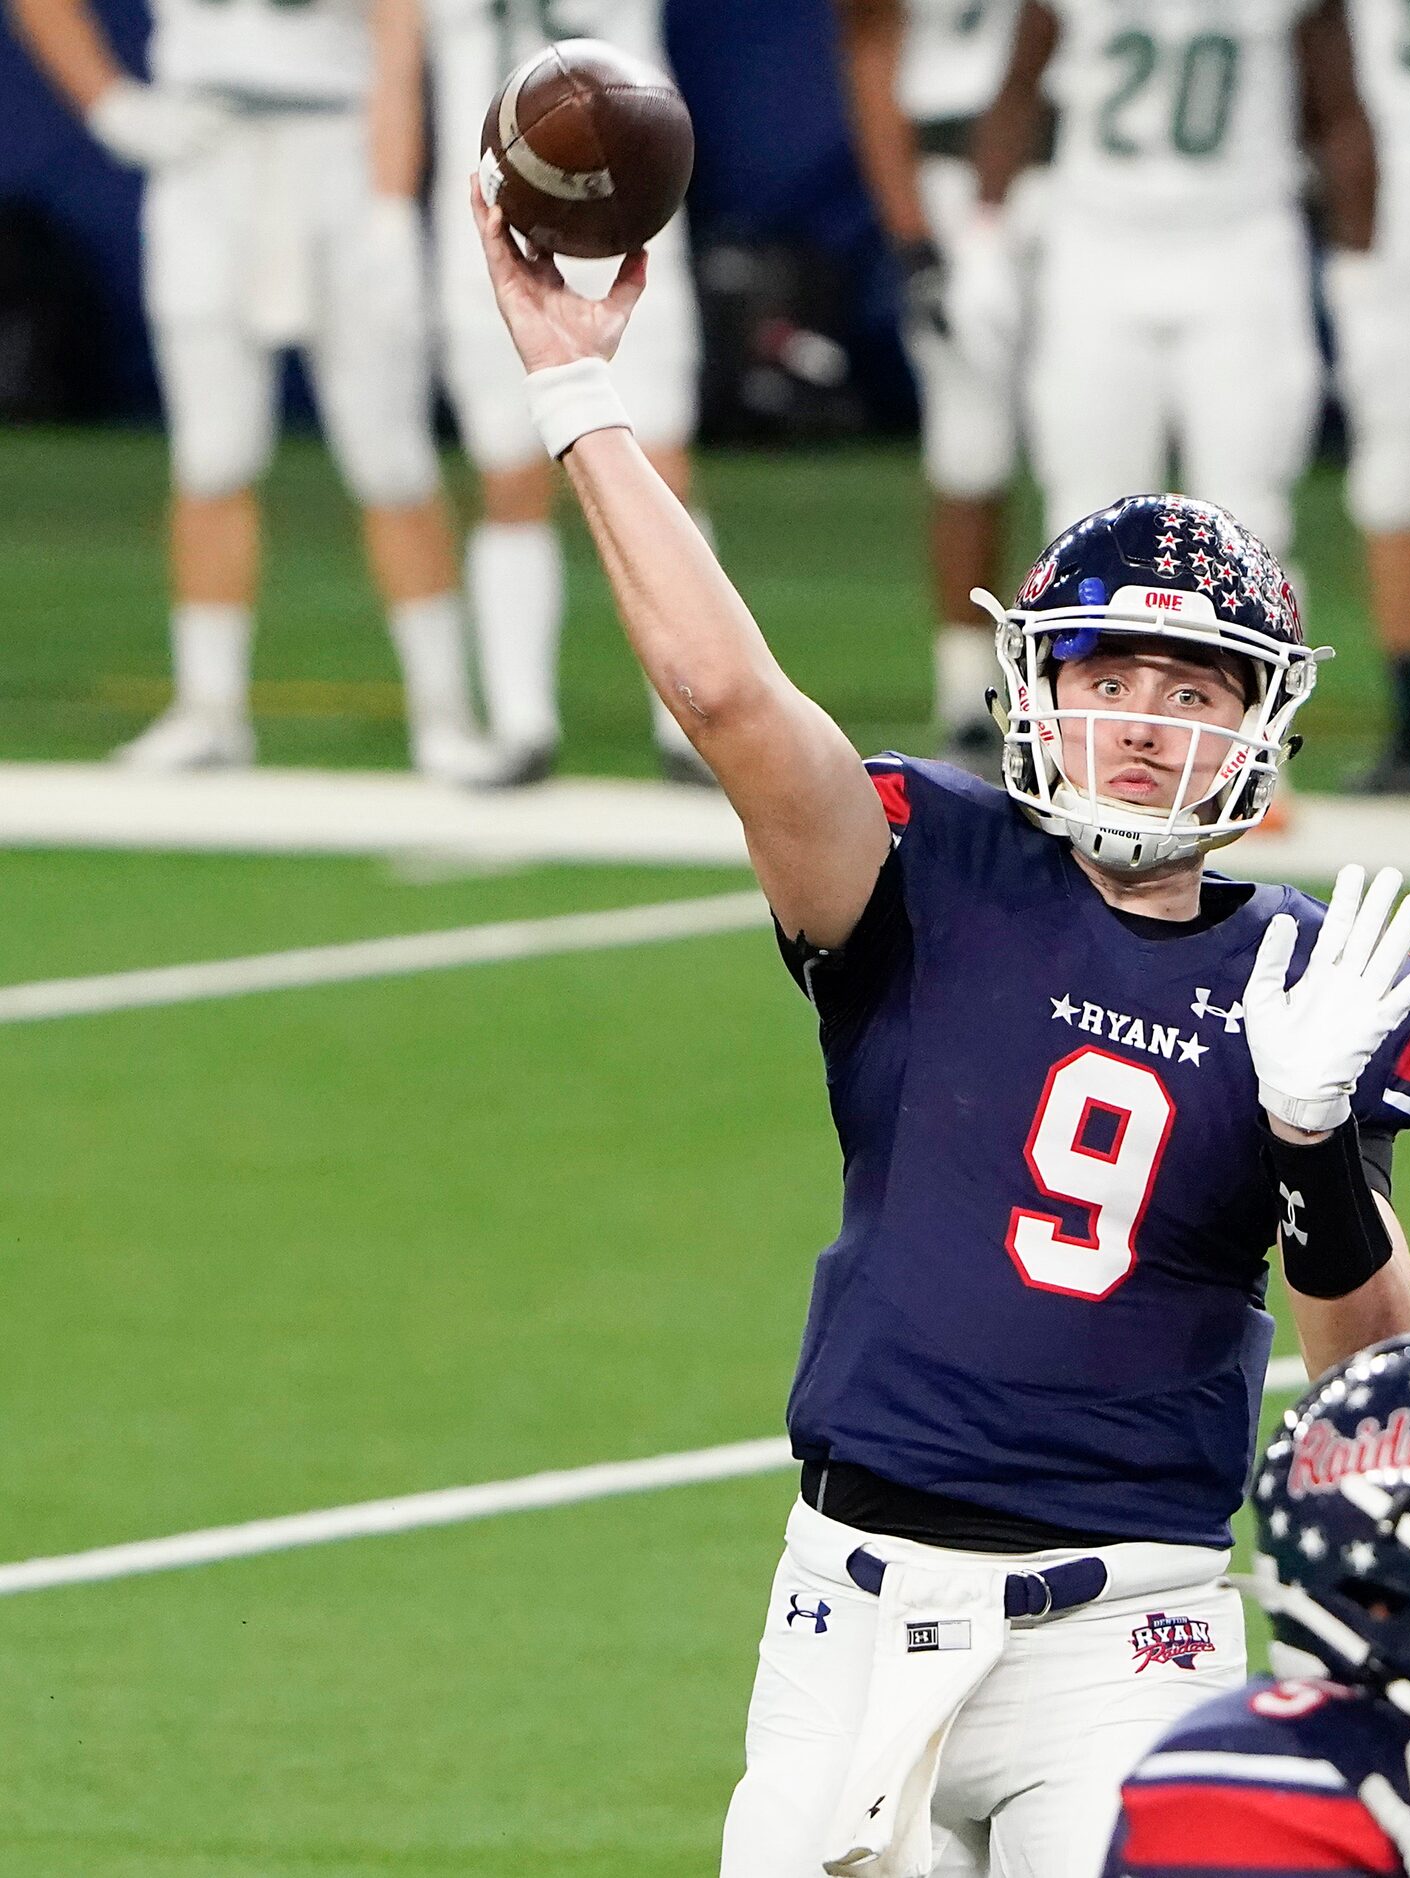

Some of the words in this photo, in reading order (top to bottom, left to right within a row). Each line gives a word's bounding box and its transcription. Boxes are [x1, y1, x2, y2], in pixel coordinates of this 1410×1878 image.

[1098, 30, 1240, 156] 20
[1145, 591, 1183, 611] ONE
[1078, 1001, 1180, 1059] RYAN
[1004, 1044, 1177, 1302] 9
[1134, 1621, 1211, 1651] RYAN
